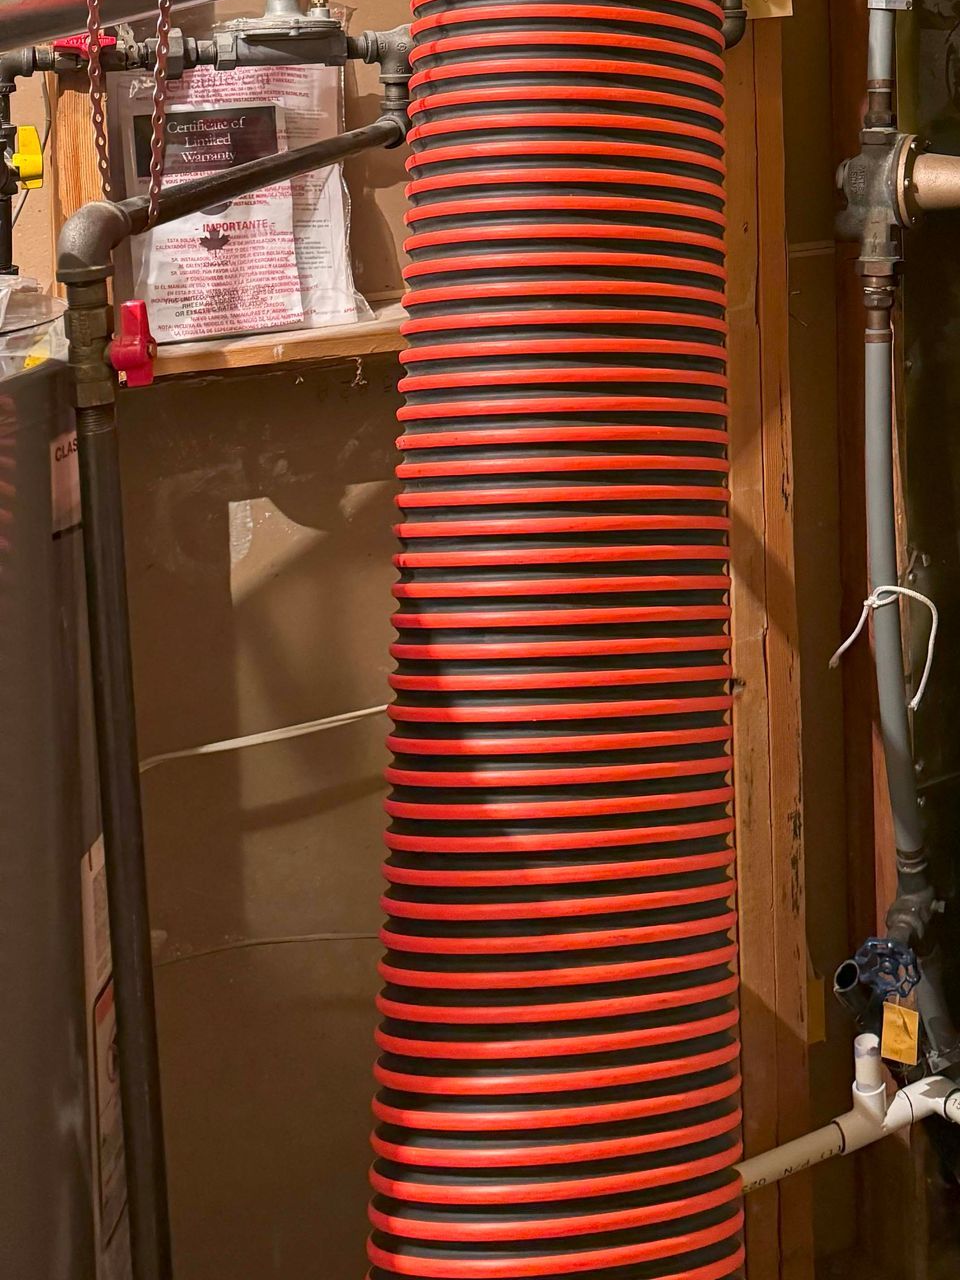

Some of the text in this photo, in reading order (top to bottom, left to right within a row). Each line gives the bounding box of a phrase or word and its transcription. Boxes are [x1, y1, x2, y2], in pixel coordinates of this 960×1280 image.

[167, 116, 246, 134] Certificate of
[184, 132, 232, 148] Limited
[181, 151, 236, 163] Warranty
[203, 219, 268, 232] IMPORTANTE
